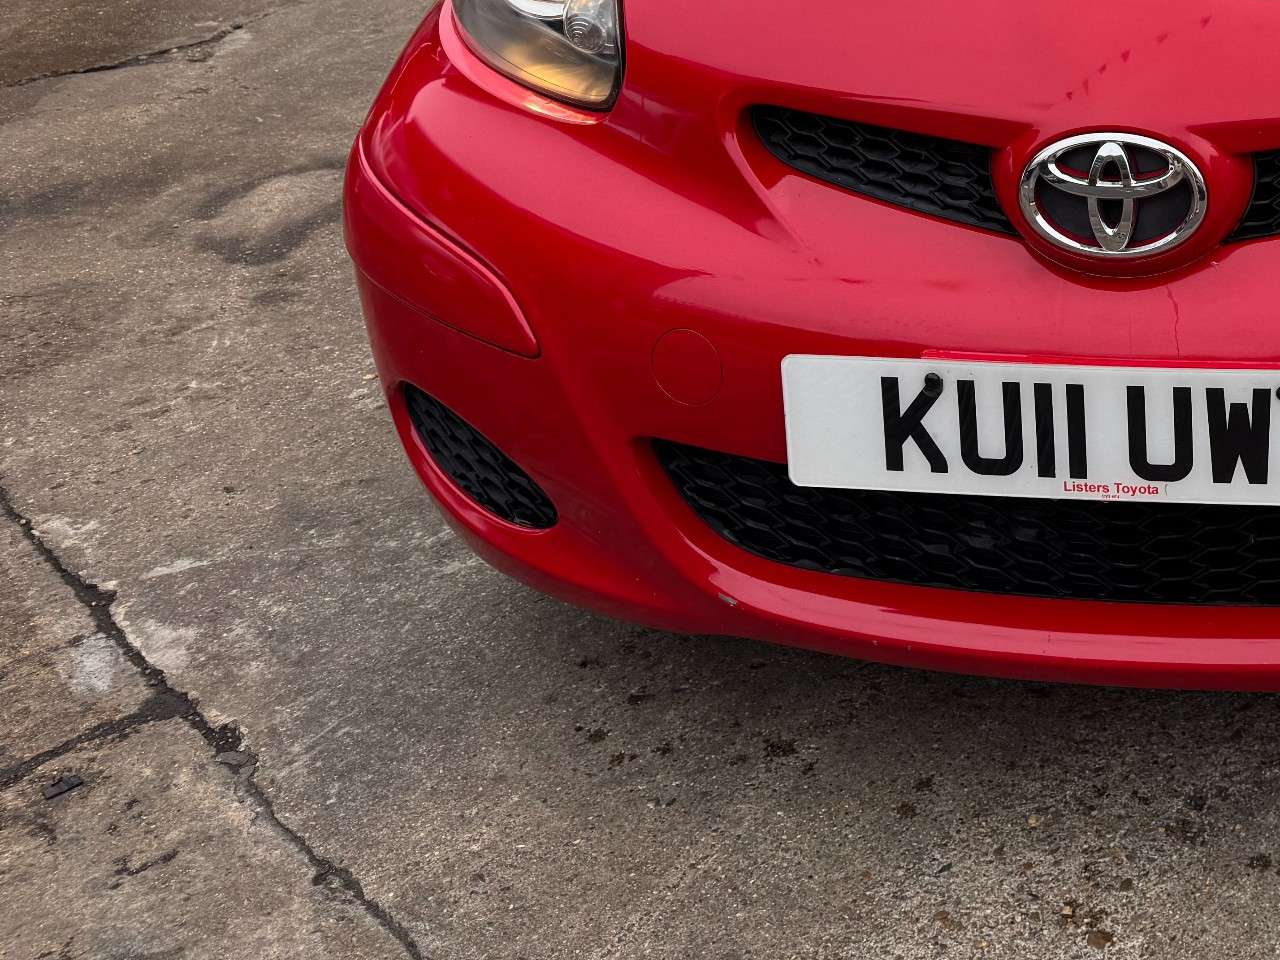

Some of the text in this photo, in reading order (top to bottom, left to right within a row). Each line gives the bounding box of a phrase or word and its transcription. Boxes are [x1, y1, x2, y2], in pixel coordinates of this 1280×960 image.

[880, 376, 1088, 480] KU11
[1063, 480, 1110, 494] Listers
[1114, 482, 1159, 497] Toyota
